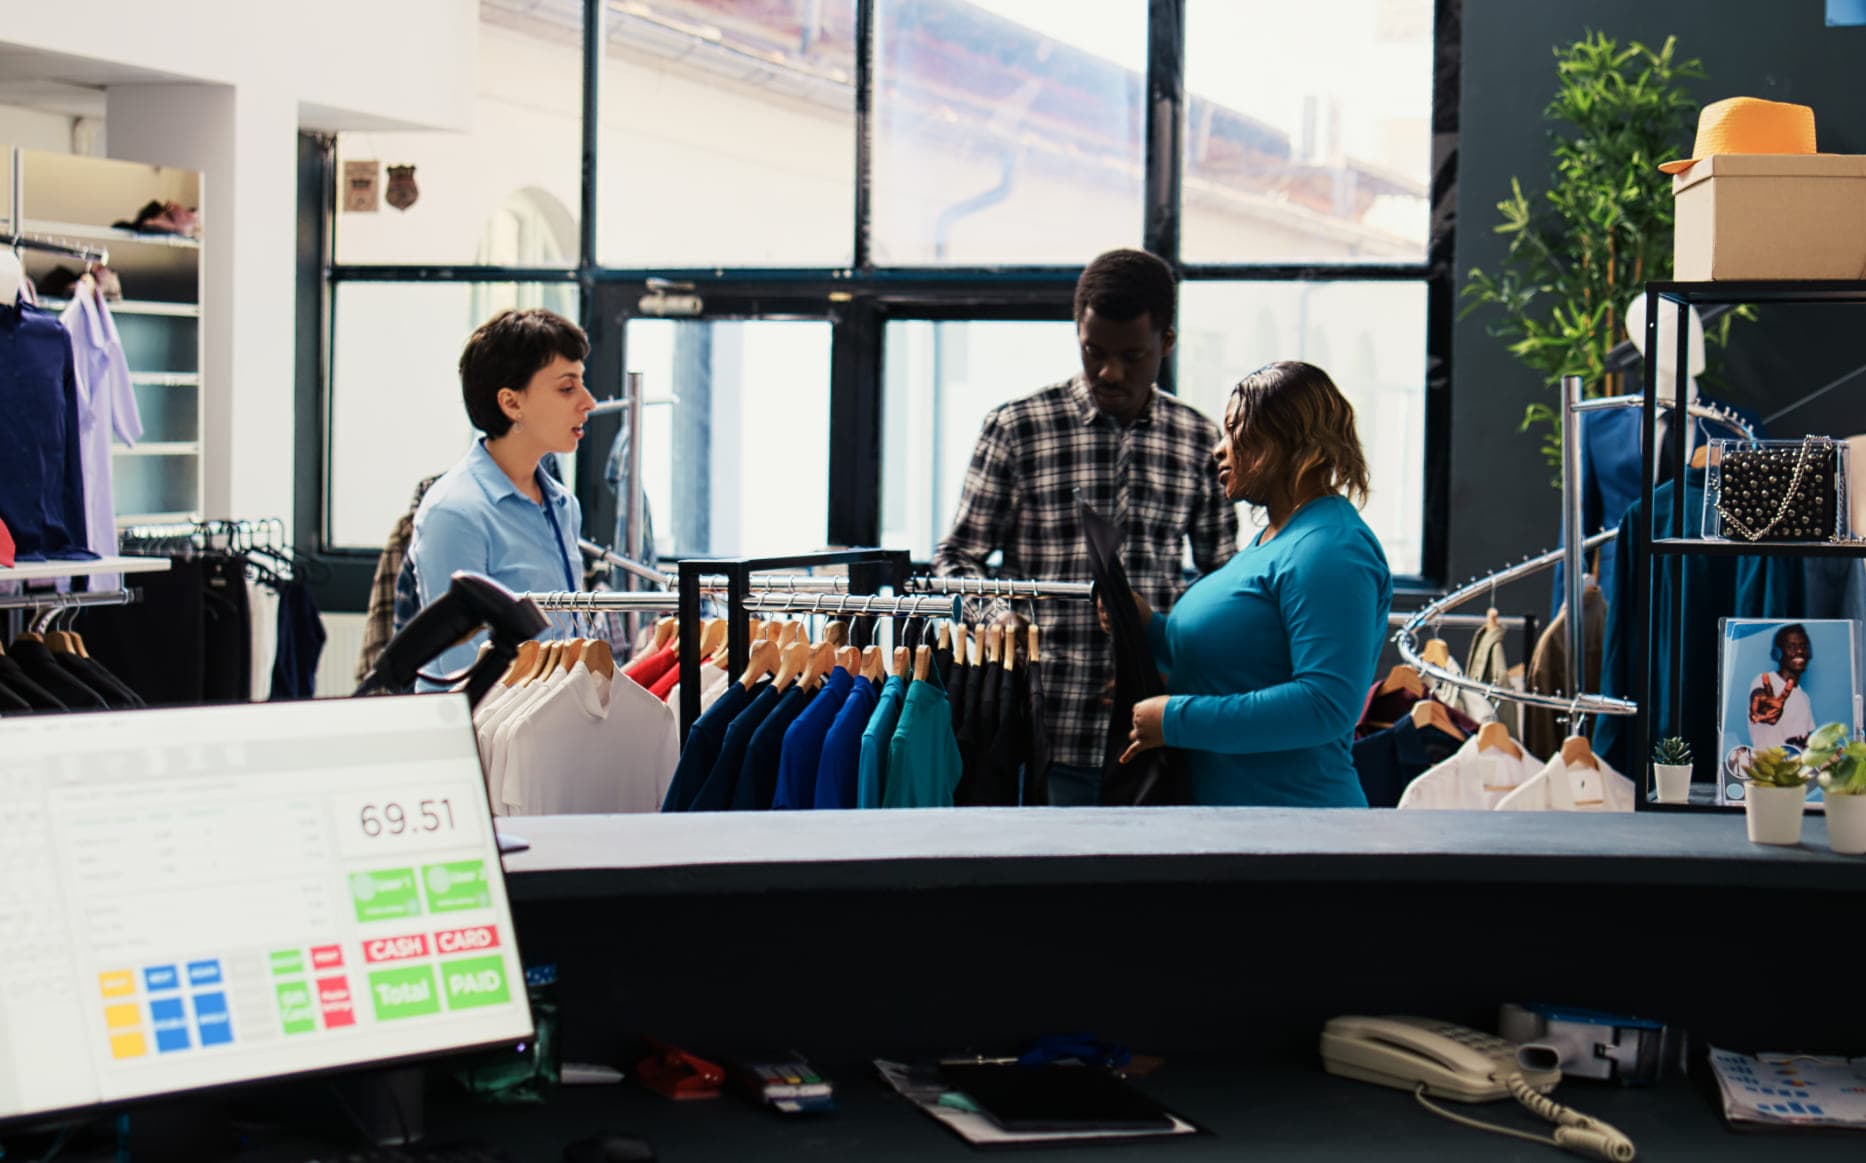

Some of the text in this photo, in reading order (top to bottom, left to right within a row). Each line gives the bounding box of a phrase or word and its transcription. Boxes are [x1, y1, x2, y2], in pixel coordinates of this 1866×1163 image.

[360, 798, 454, 837] 69.51
[369, 935, 424, 961] CASH
[438, 927, 492, 951] CARD
[376, 977, 430, 1006] Total
[449, 969, 500, 997] PAID
